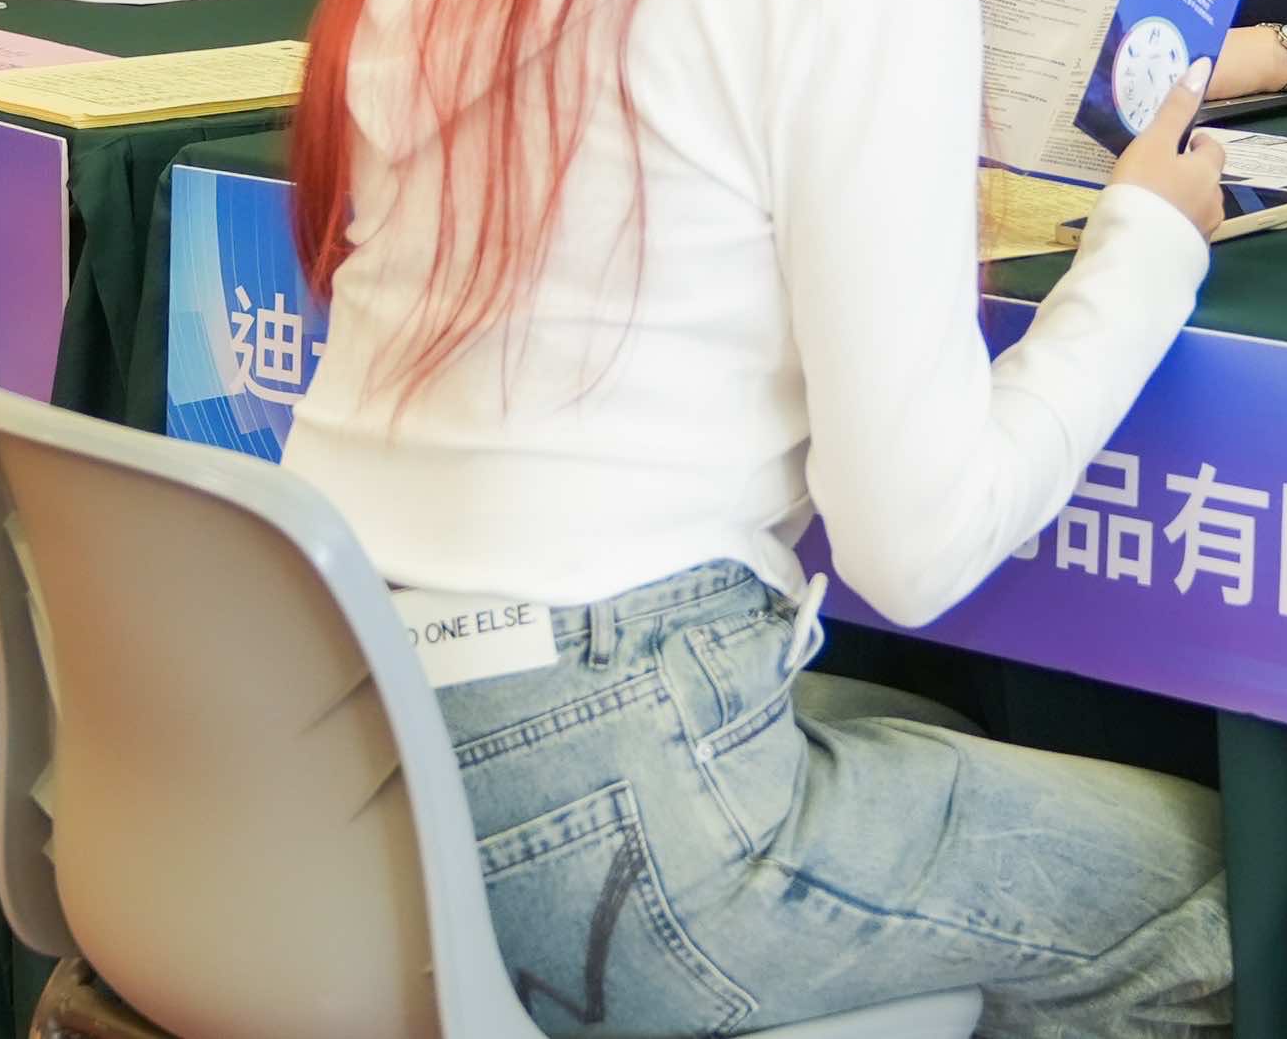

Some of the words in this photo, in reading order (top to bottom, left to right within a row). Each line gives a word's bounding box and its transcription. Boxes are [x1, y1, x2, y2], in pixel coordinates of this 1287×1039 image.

[229, 286, 326, 406] 迪
[425, 615, 470, 644] ONE
[476, 603, 532, 633] ELSE
